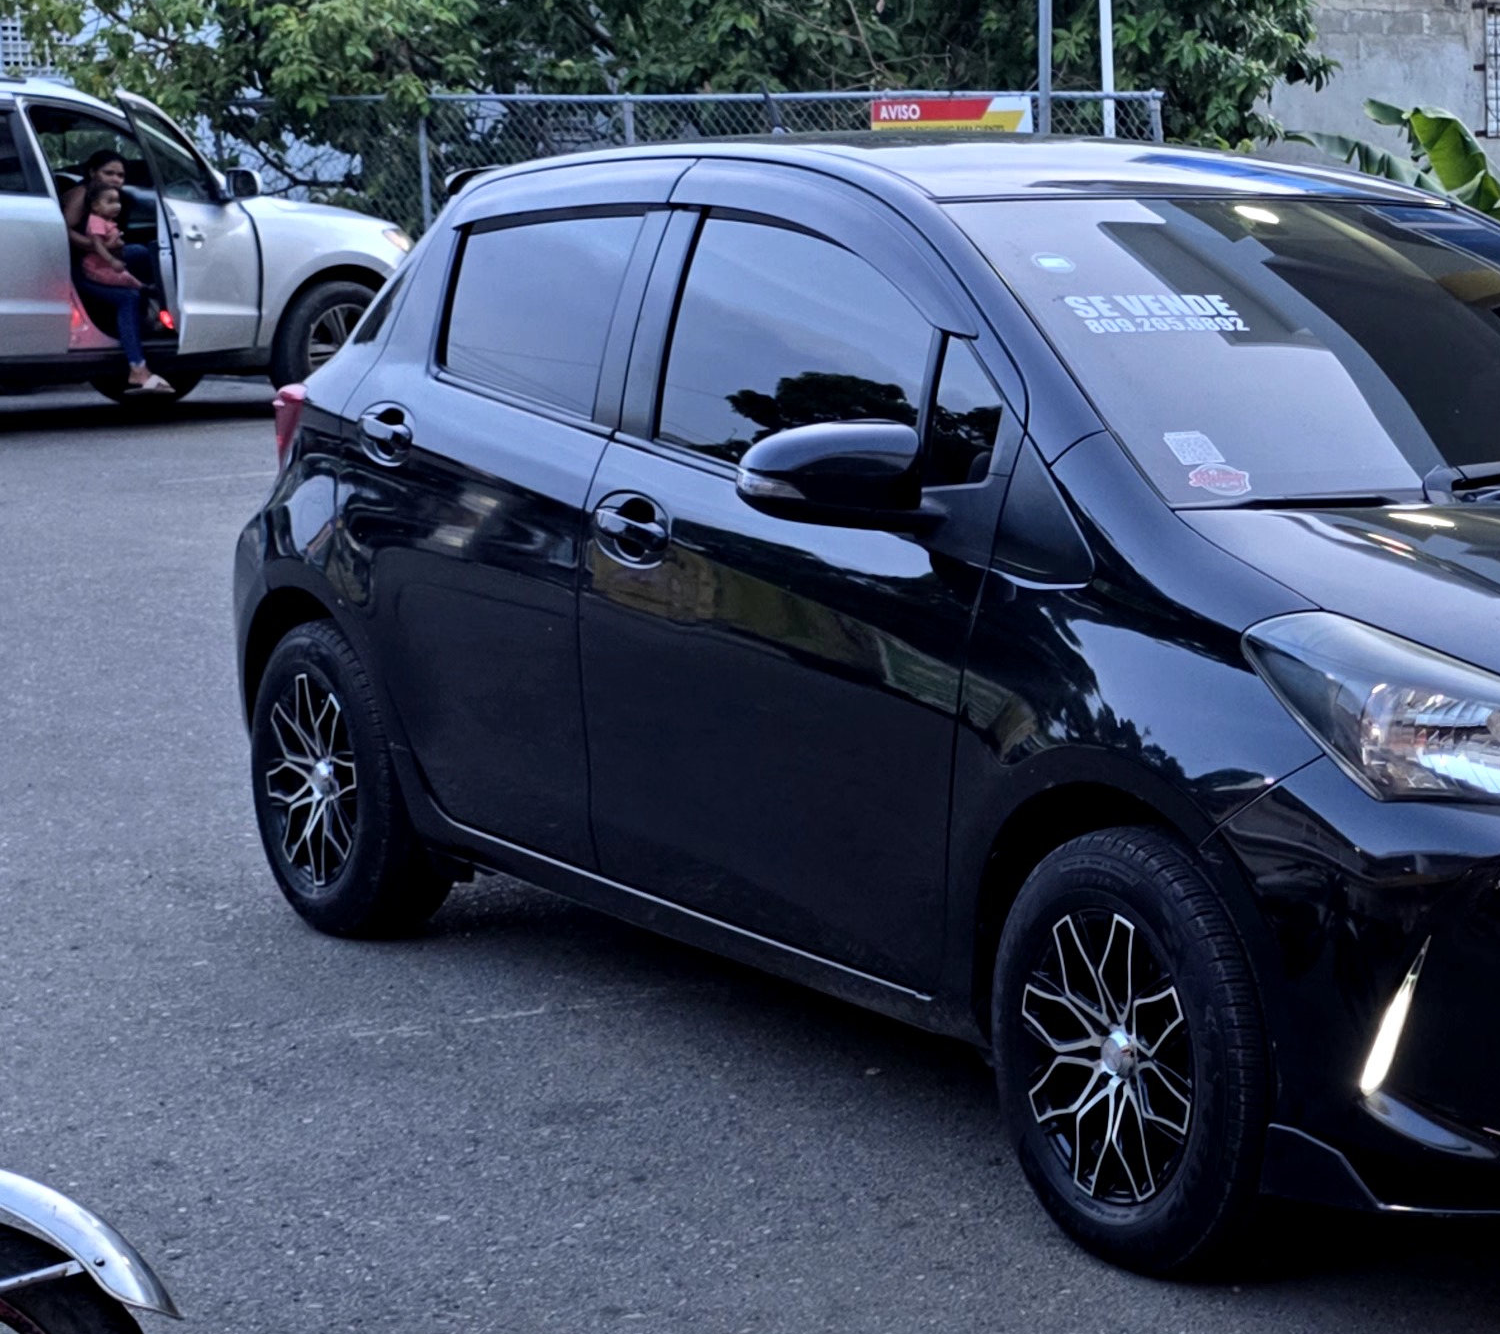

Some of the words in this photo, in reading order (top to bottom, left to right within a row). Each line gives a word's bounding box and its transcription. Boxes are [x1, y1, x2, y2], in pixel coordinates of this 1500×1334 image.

[880, 104, 921, 120] AVISO
[1064, 295, 1121, 318] SE
[1112, 295, 1239, 317] VENDE
